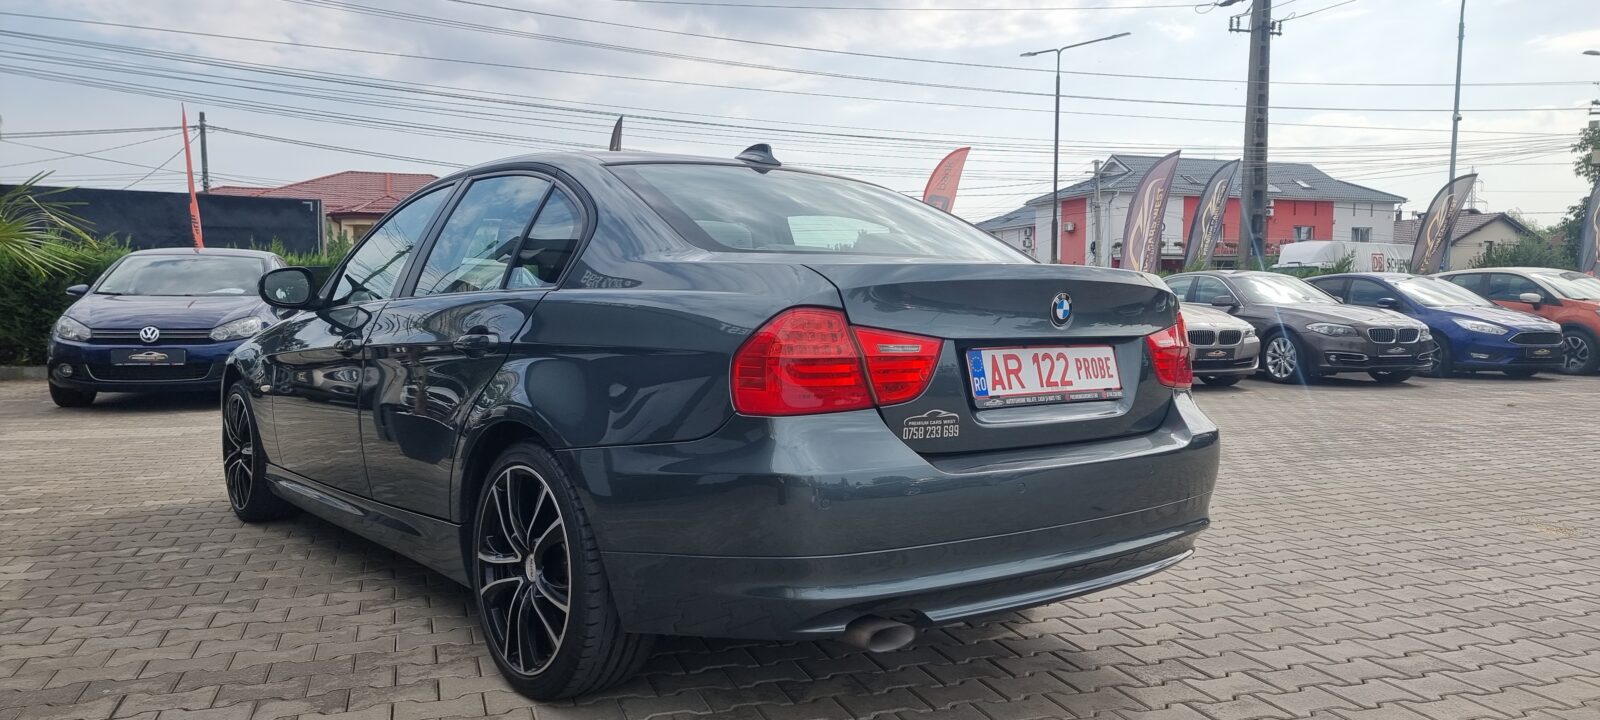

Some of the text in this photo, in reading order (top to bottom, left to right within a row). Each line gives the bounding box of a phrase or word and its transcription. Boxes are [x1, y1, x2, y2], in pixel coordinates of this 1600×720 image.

[1153, 187, 1165, 219] WEST
[1386, 257, 1411, 270] SCHEN
[141, 326, 158, 341] VW
[991, 352, 1114, 391] AR 122 PROBE
[974, 377, 987, 391] RO
[902, 424, 960, 440] 0758 233 699
